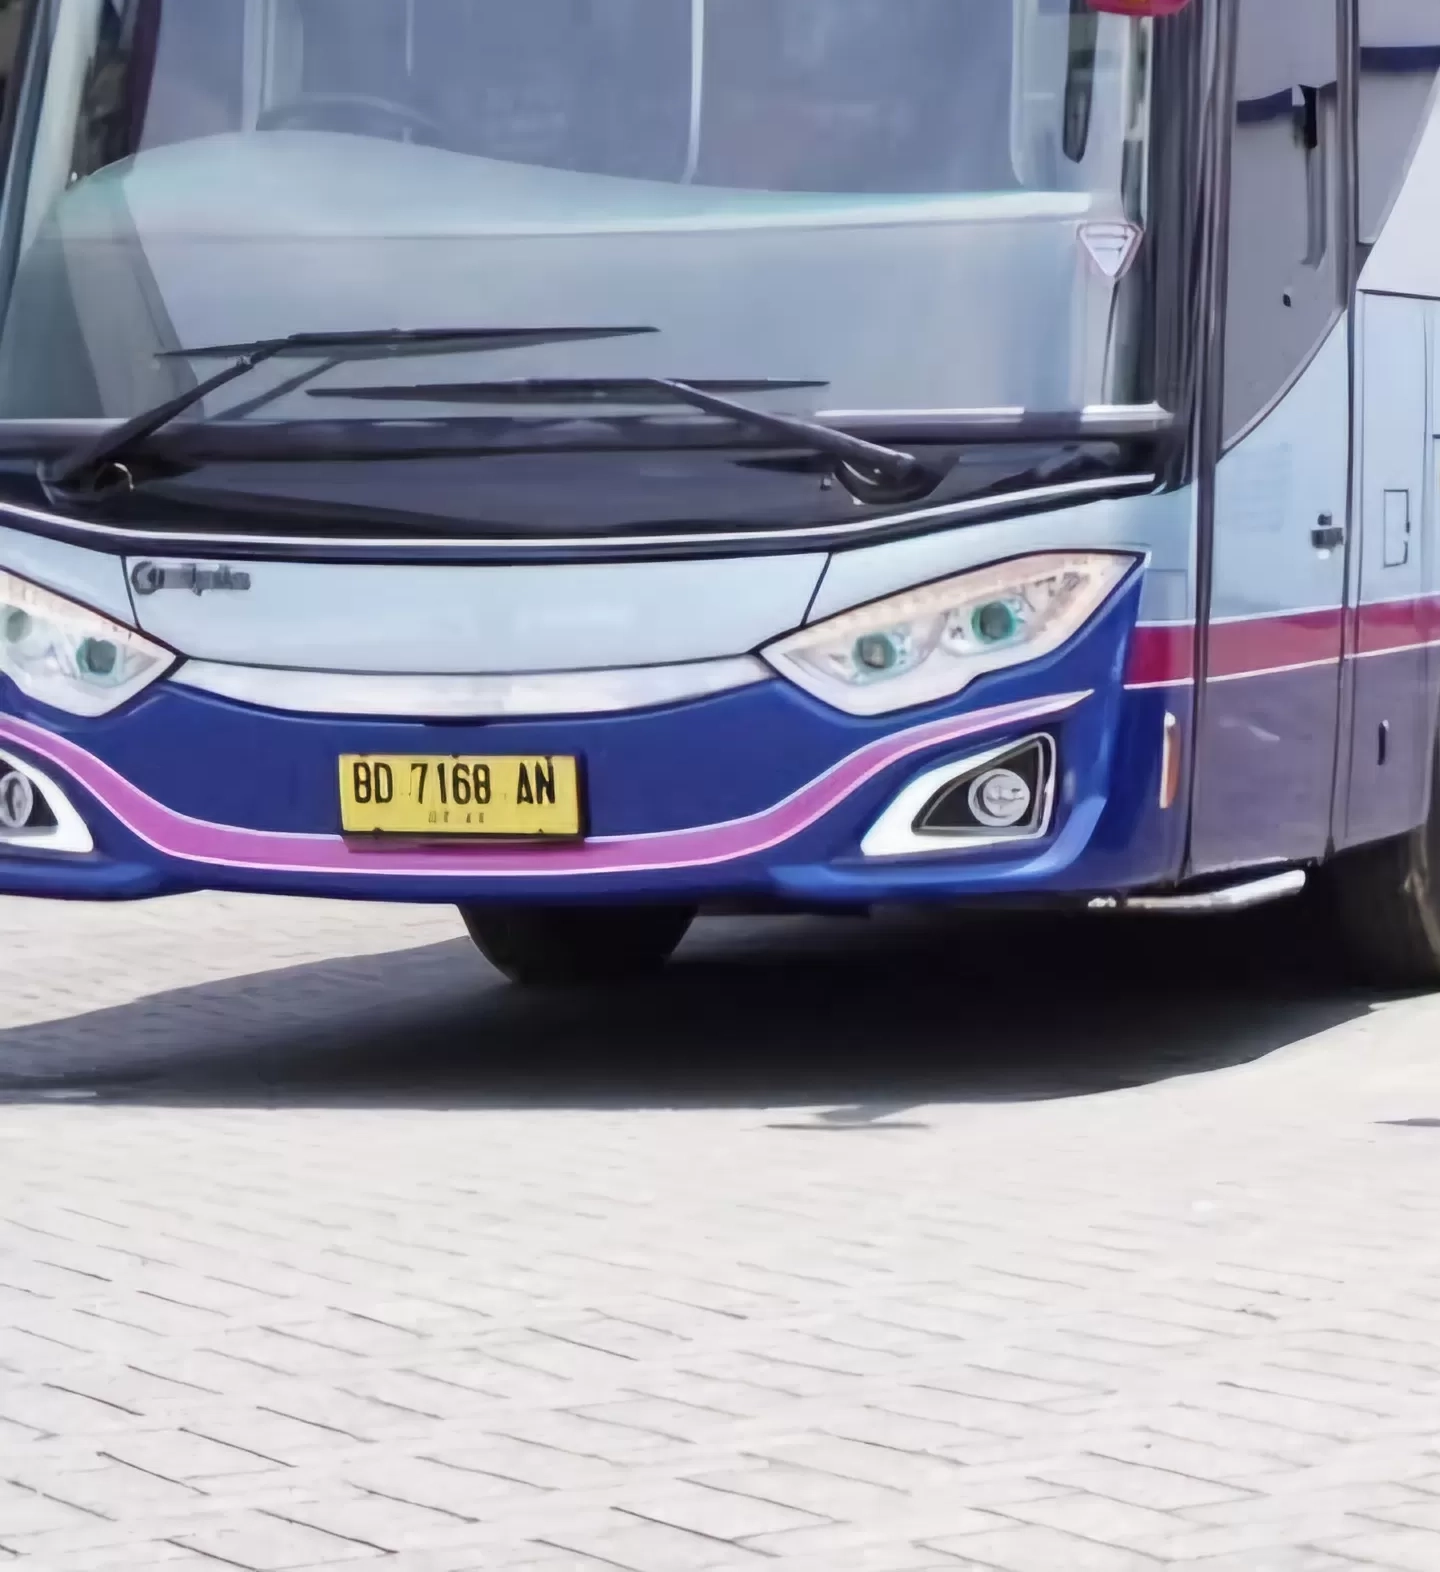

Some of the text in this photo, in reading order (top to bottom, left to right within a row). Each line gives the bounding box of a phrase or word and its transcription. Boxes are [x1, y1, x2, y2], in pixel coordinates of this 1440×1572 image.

[353, 761, 556, 805] BD 7168 AN
